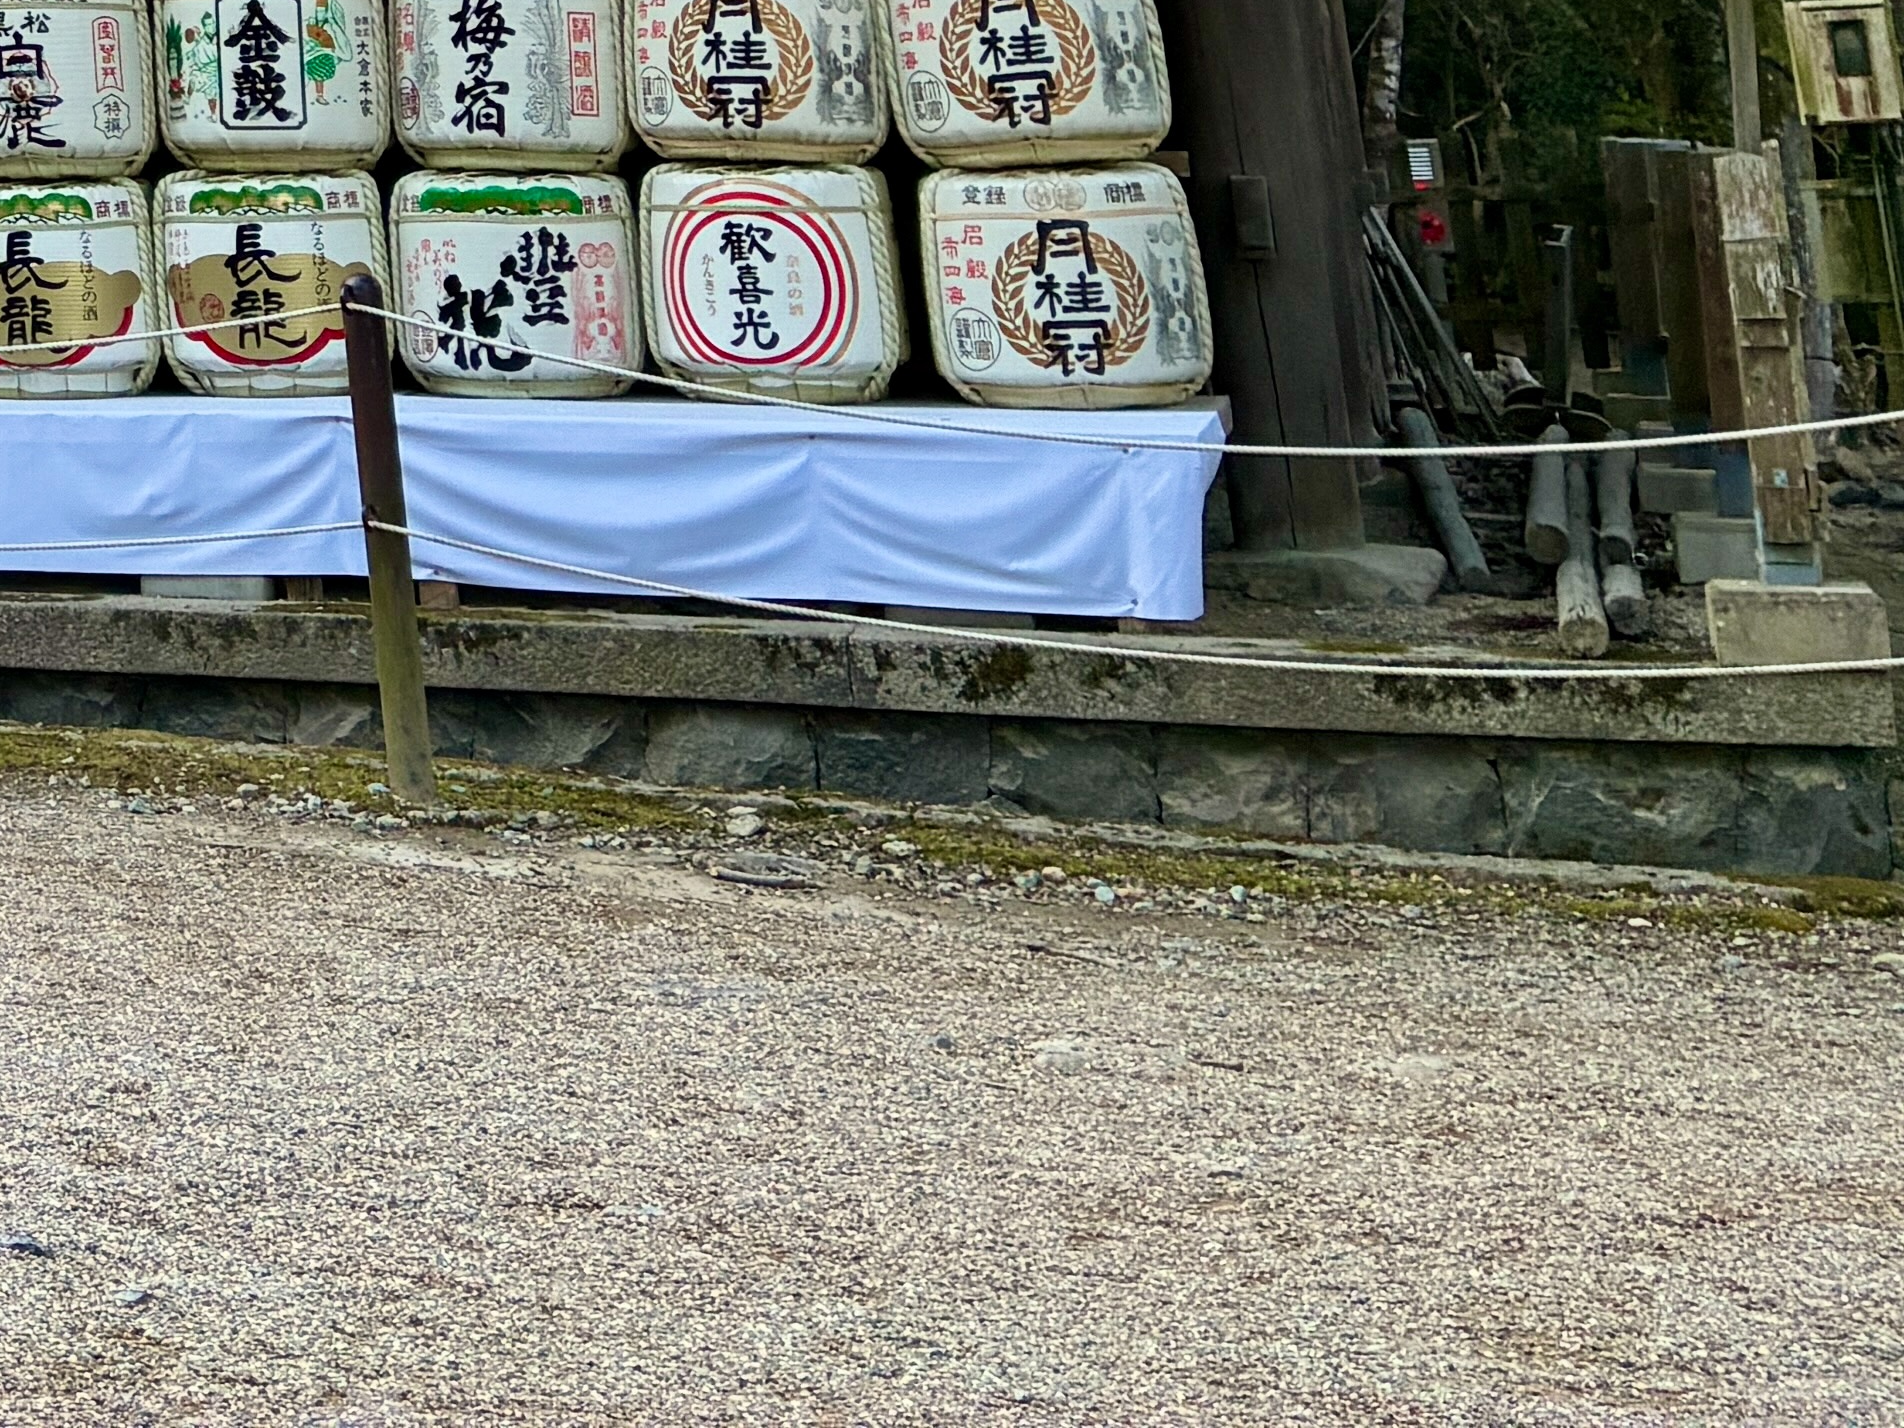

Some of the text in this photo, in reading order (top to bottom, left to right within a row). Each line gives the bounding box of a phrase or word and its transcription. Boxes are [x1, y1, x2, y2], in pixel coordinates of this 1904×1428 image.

[79, 230, 99, 323] なるほどの酒
[223, 223, 308, 350] 長龍
[701, 253, 717, 318] かんきこう
[718, 220, 781, 351] 歓喜光
[1030, 218, 1111, 378] 月桂冠
